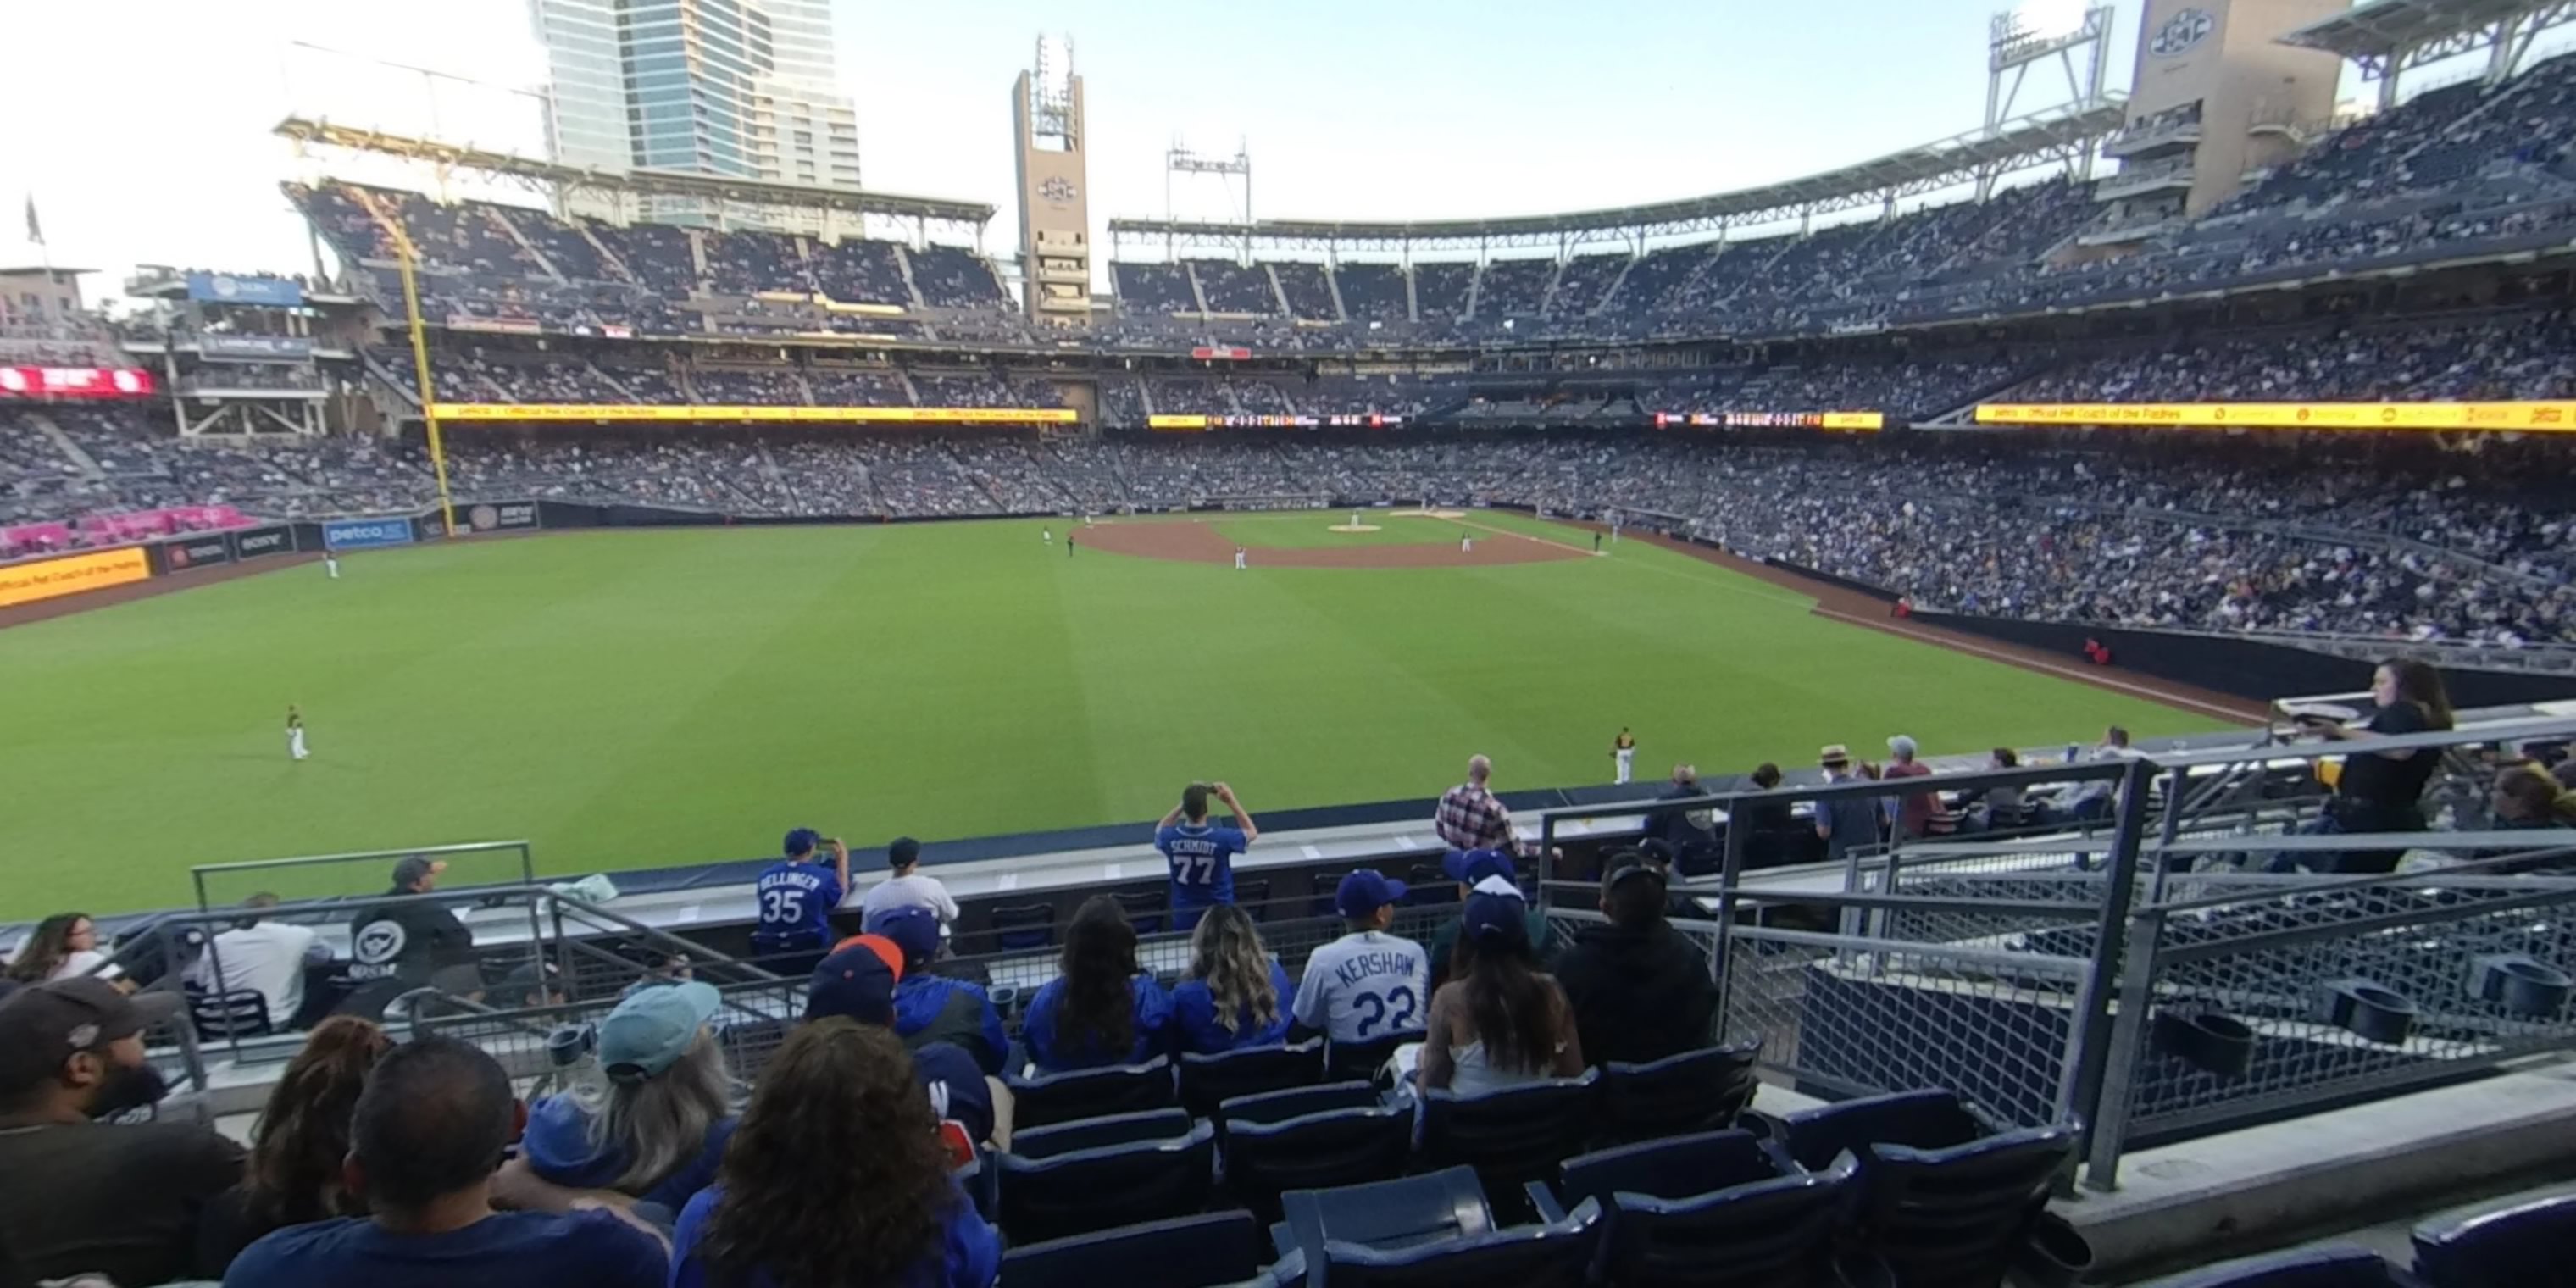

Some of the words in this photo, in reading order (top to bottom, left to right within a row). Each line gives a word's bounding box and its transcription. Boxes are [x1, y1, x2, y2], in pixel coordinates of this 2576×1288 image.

[330, 526, 383, 543] petco
[1170, 838, 1218, 856] SCHMIDT
[1173, 855, 1216, 886] 77
[763, 891, 804, 924] 35
[1335, 952, 1415, 989] KERSHAW
[1352, 985, 1416, 1036] 22
